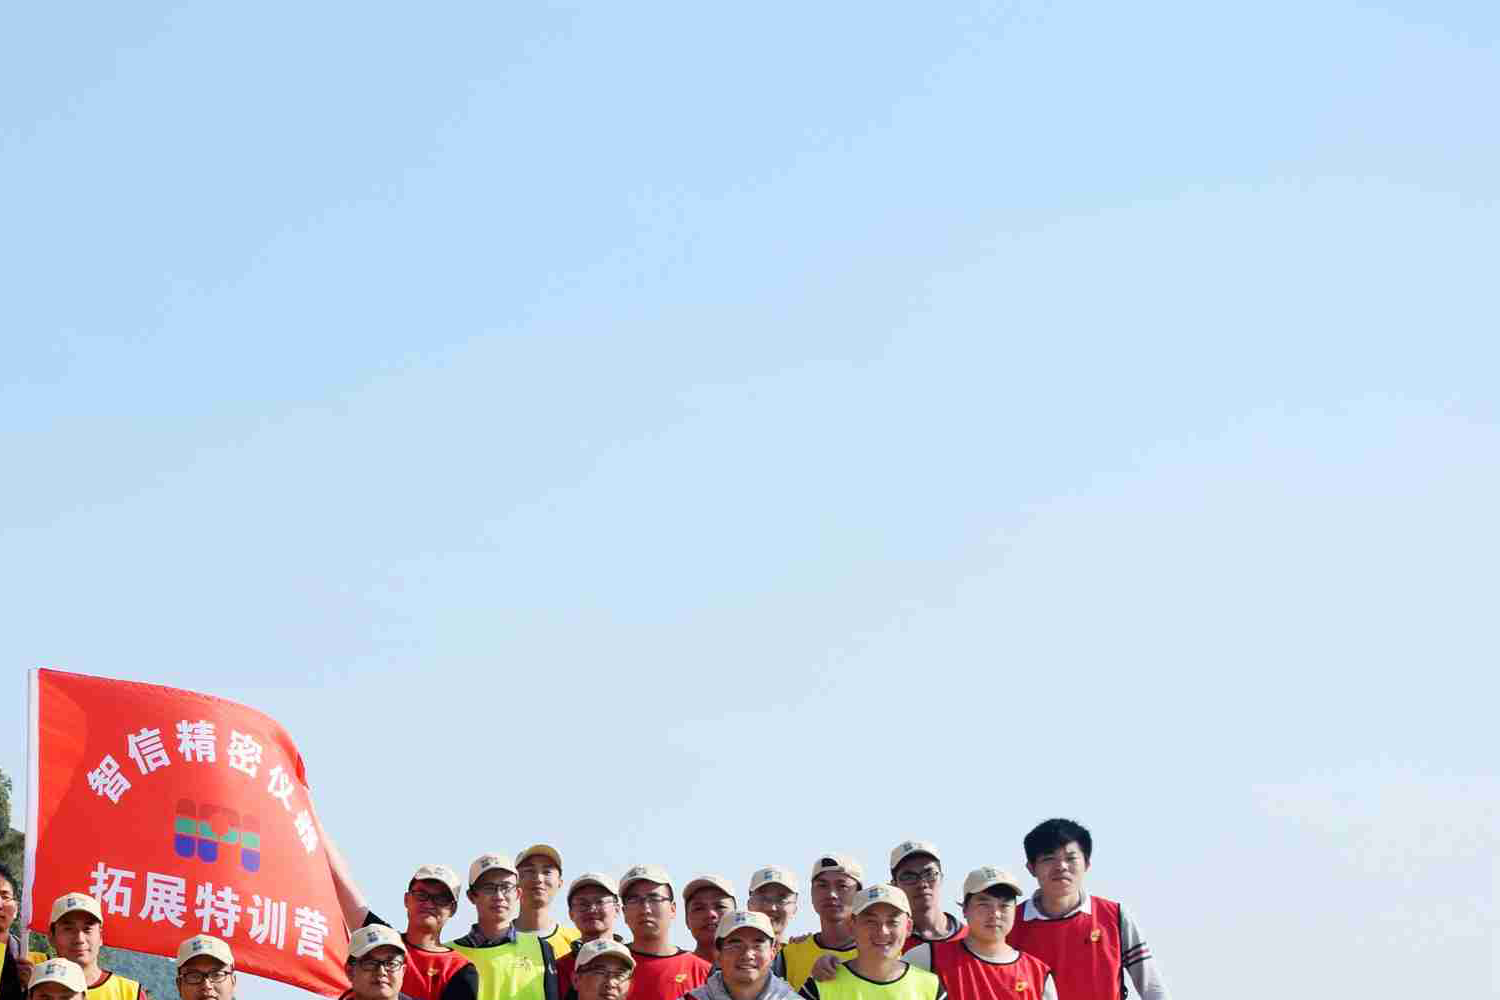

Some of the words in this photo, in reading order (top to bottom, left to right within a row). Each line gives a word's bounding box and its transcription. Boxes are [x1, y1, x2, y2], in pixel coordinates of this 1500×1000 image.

[88, 861, 330, 961] 拓展特训营
